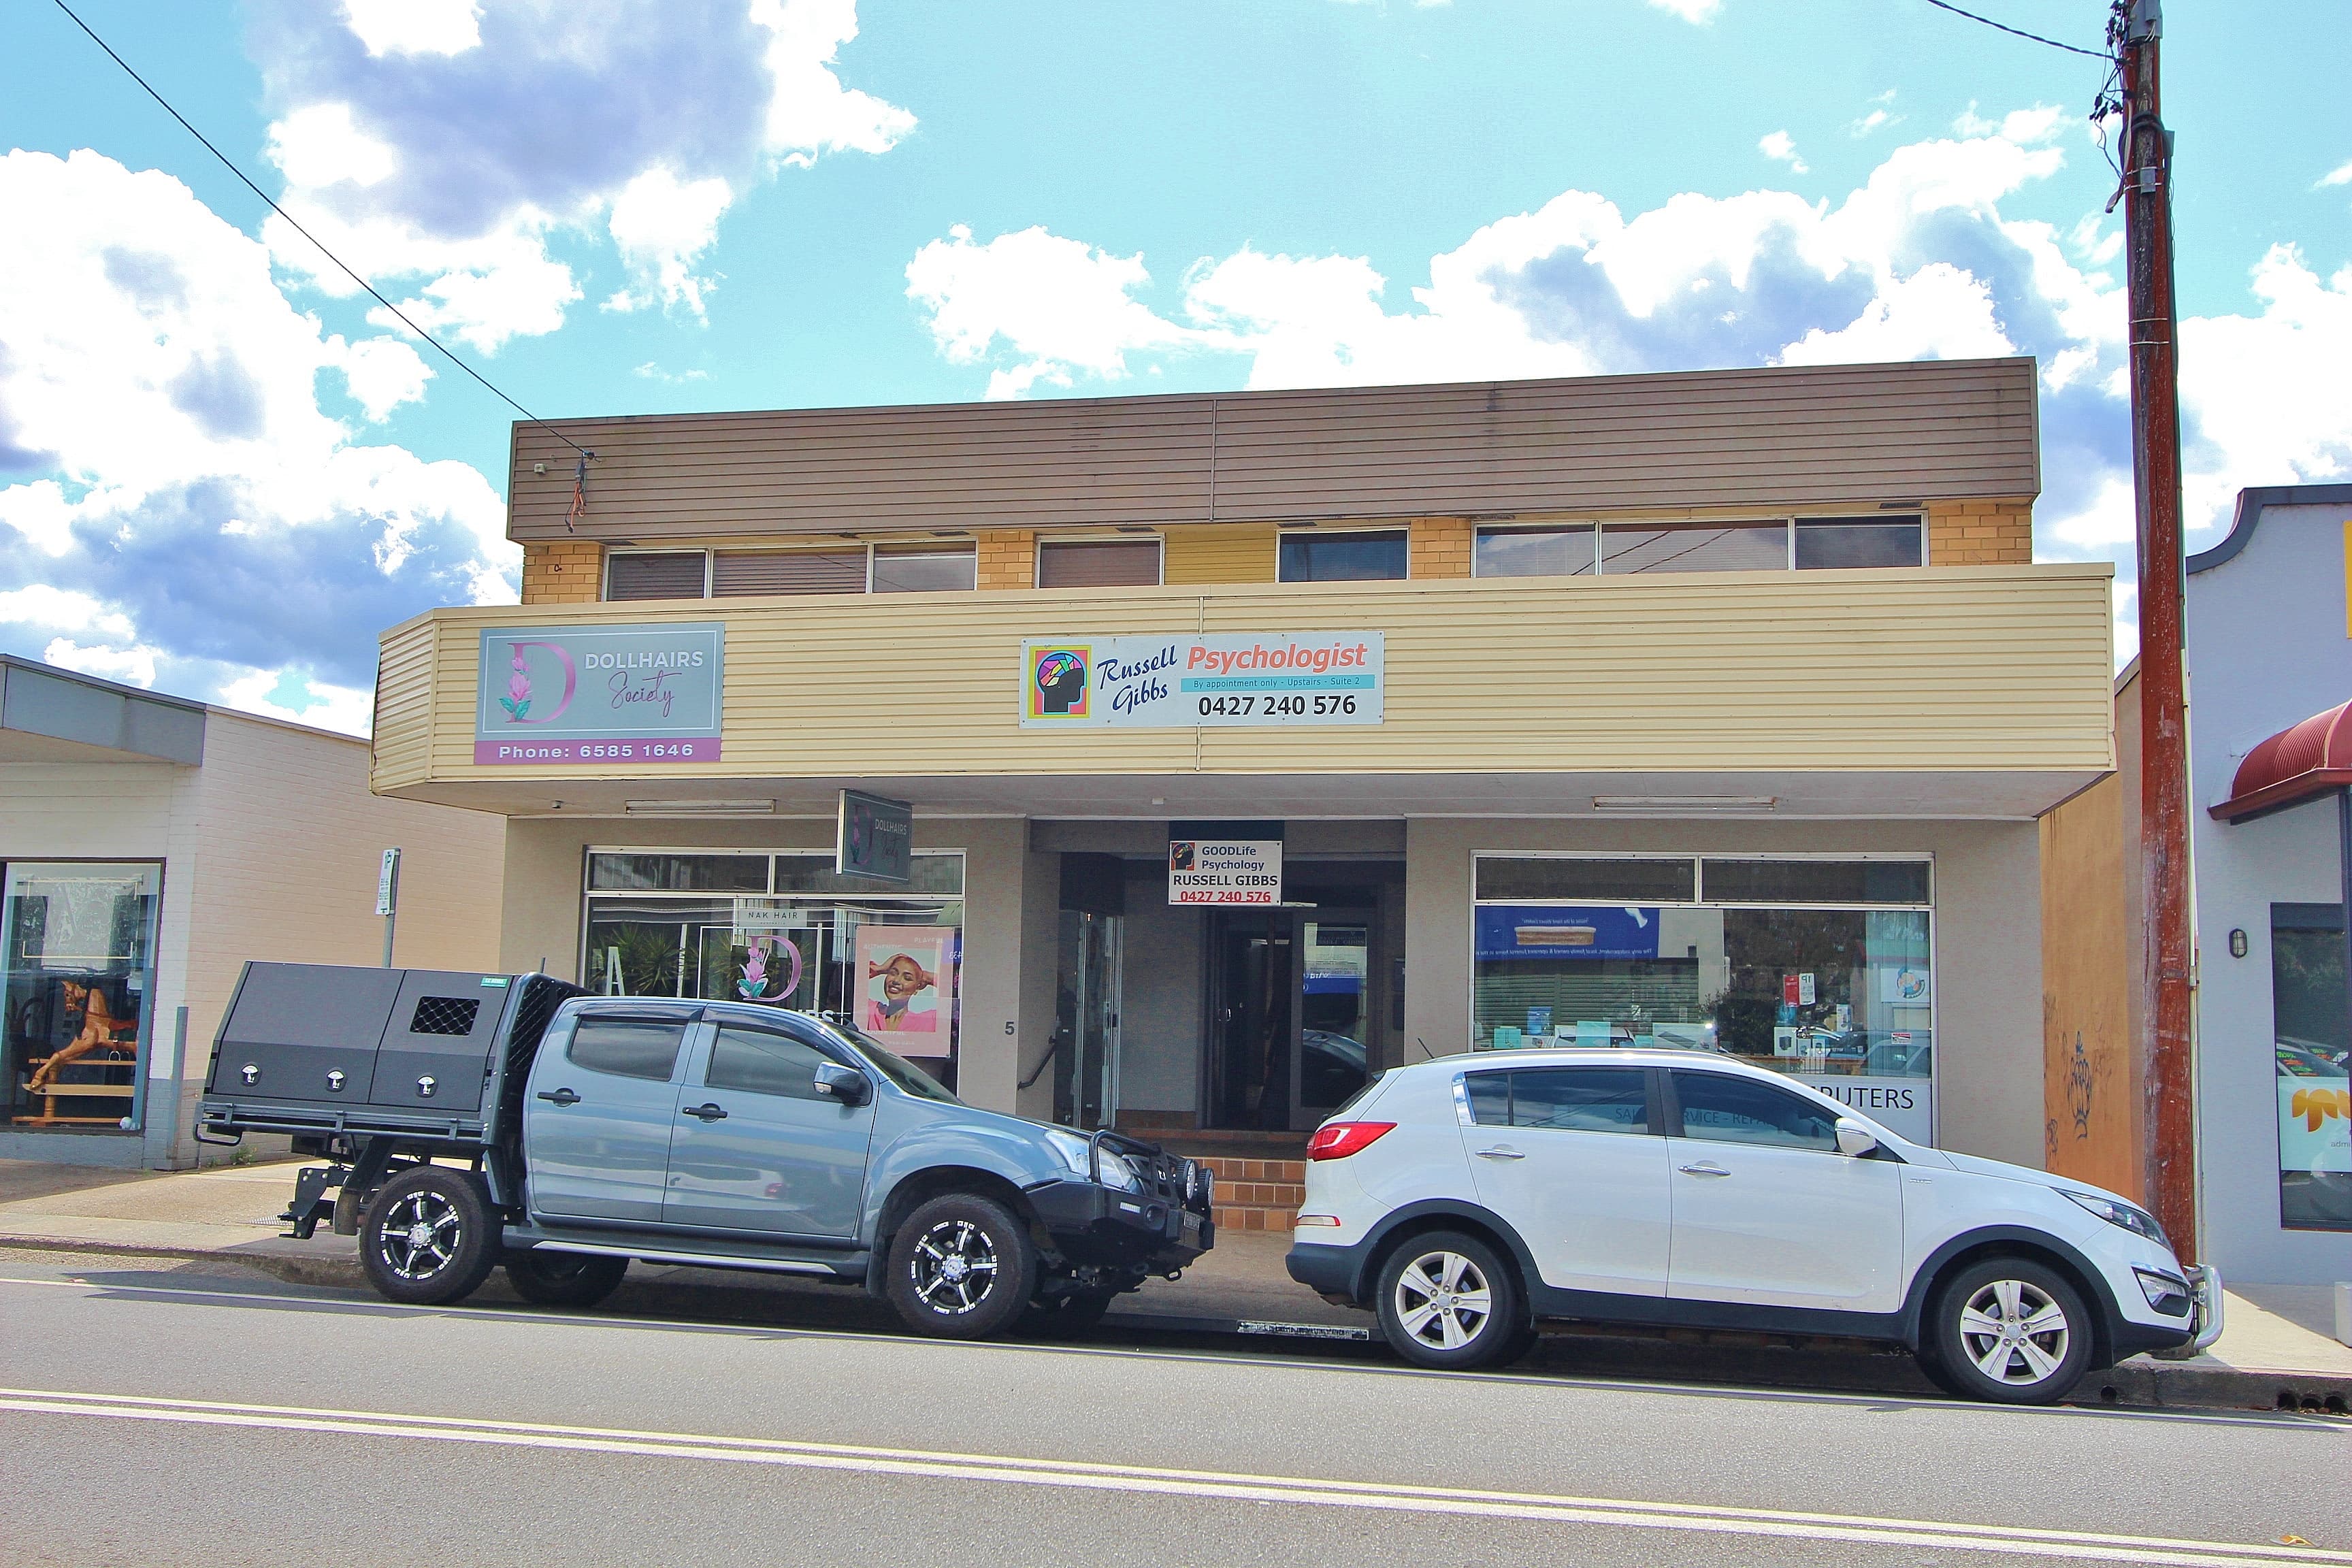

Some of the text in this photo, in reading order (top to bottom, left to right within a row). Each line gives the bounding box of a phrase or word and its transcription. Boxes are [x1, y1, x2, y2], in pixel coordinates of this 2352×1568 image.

[584, 651, 704, 670] DOLLHAIRS
[1186, 642, 1368, 675] Psychologist
[1096, 644, 1178, 690] Russell
[1193, 680, 1203, 690] By
[1206, 680, 1258, 690] appointment
[1260, 679, 1277, 689] only
[1287, 678, 1321, 687] Upstairs
[1330, 676, 1352, 685] Suite
[1355, 676, 1360, 685] 2
[608, 670, 683, 718] Society
[1112, 676, 1168, 715] Gibbs
[1198, 694, 1357, 716] 0427 240 576
[498, 743, 694, 759] Phone: 6585 1646
[875, 819, 907, 835] DOLLHAIRS
[1202, 846, 1257, 856] GOODLife
[1202, 860, 1264, 872] Psychology
[1173, 875, 1278, 885] RUSSELL GIBBS
[1180, 891, 1271, 903] 0427 240 576
[1004, 1021, 1015, 1036] 5
[1811, 1086, 1914, 1109] PUTERS
